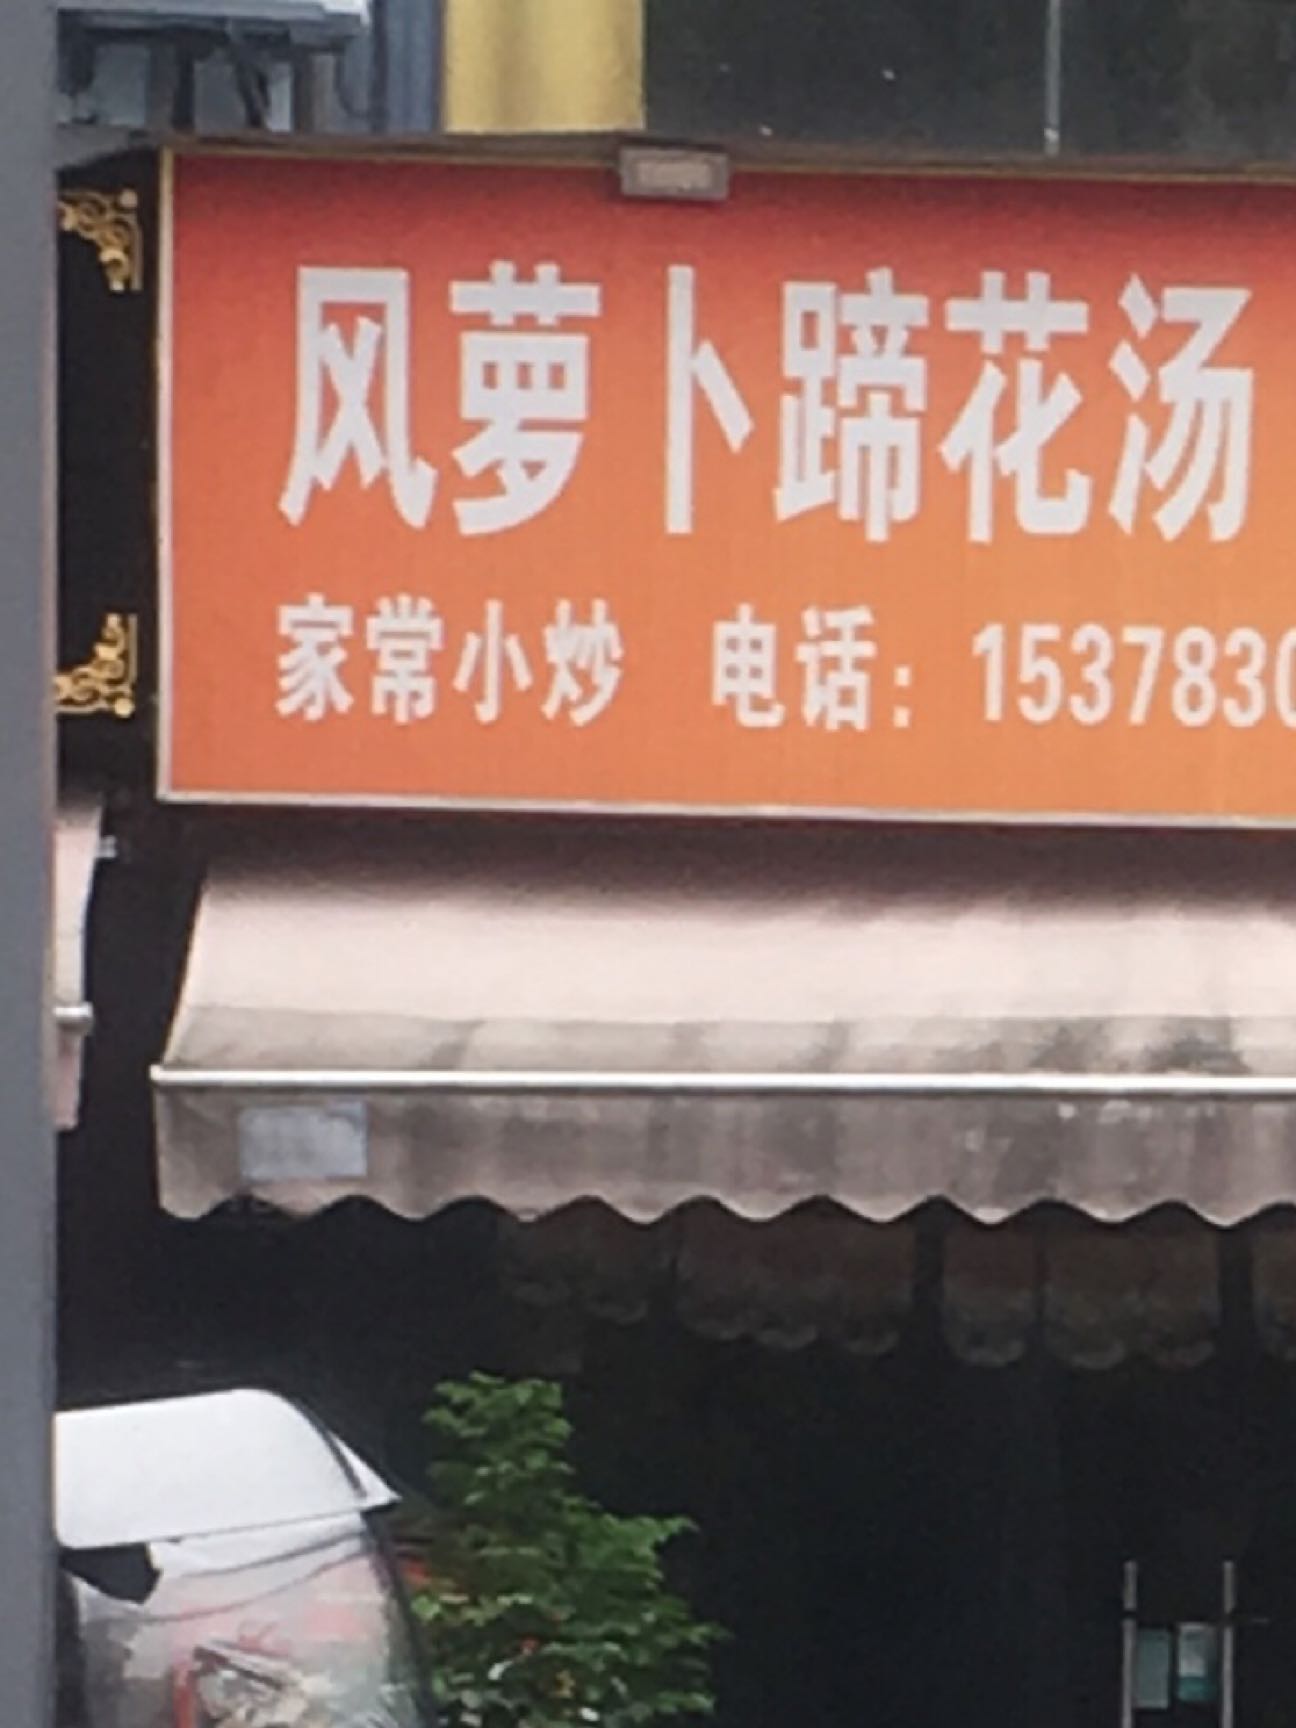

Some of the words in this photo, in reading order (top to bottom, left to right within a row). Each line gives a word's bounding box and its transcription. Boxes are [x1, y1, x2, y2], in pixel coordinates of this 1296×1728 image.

[280, 260, 1255, 540] 风萝卜蹄花汤
[275, 594, 624, 724] 家常小炒
